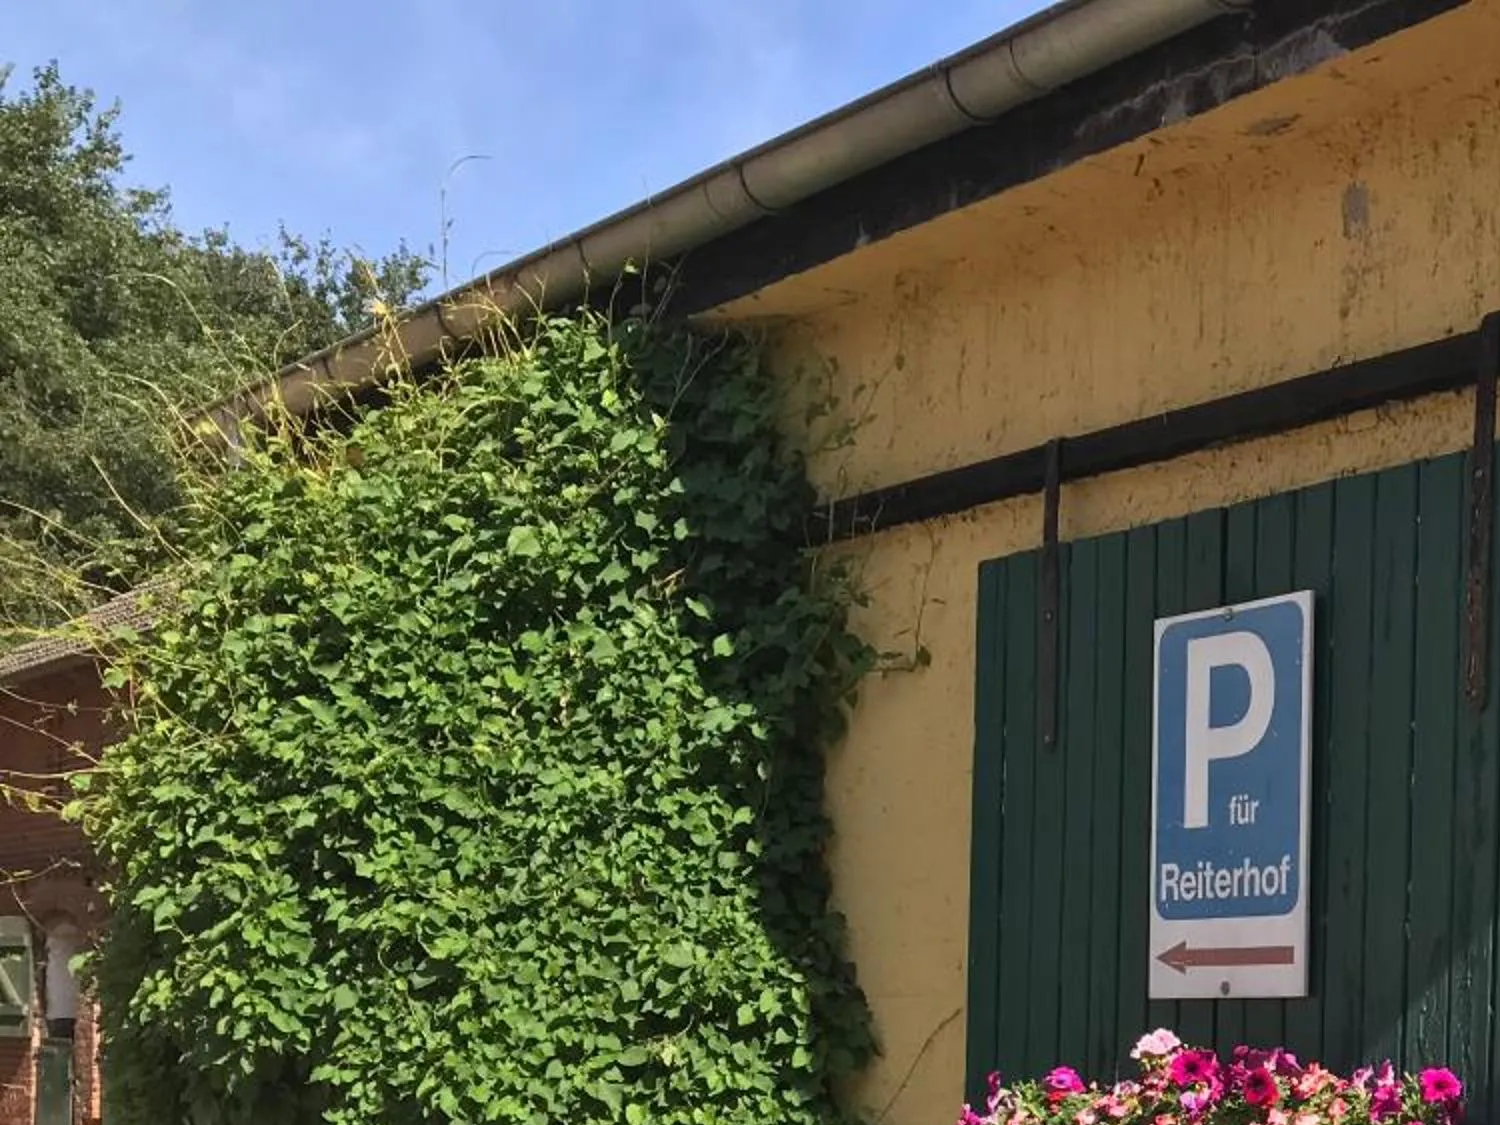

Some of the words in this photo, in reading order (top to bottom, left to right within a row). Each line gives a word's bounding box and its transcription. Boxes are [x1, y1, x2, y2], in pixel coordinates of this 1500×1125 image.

[1184, 631, 1275, 828] P
[1229, 796, 1260, 826] für
[1161, 854, 1291, 901] Reiterhof
